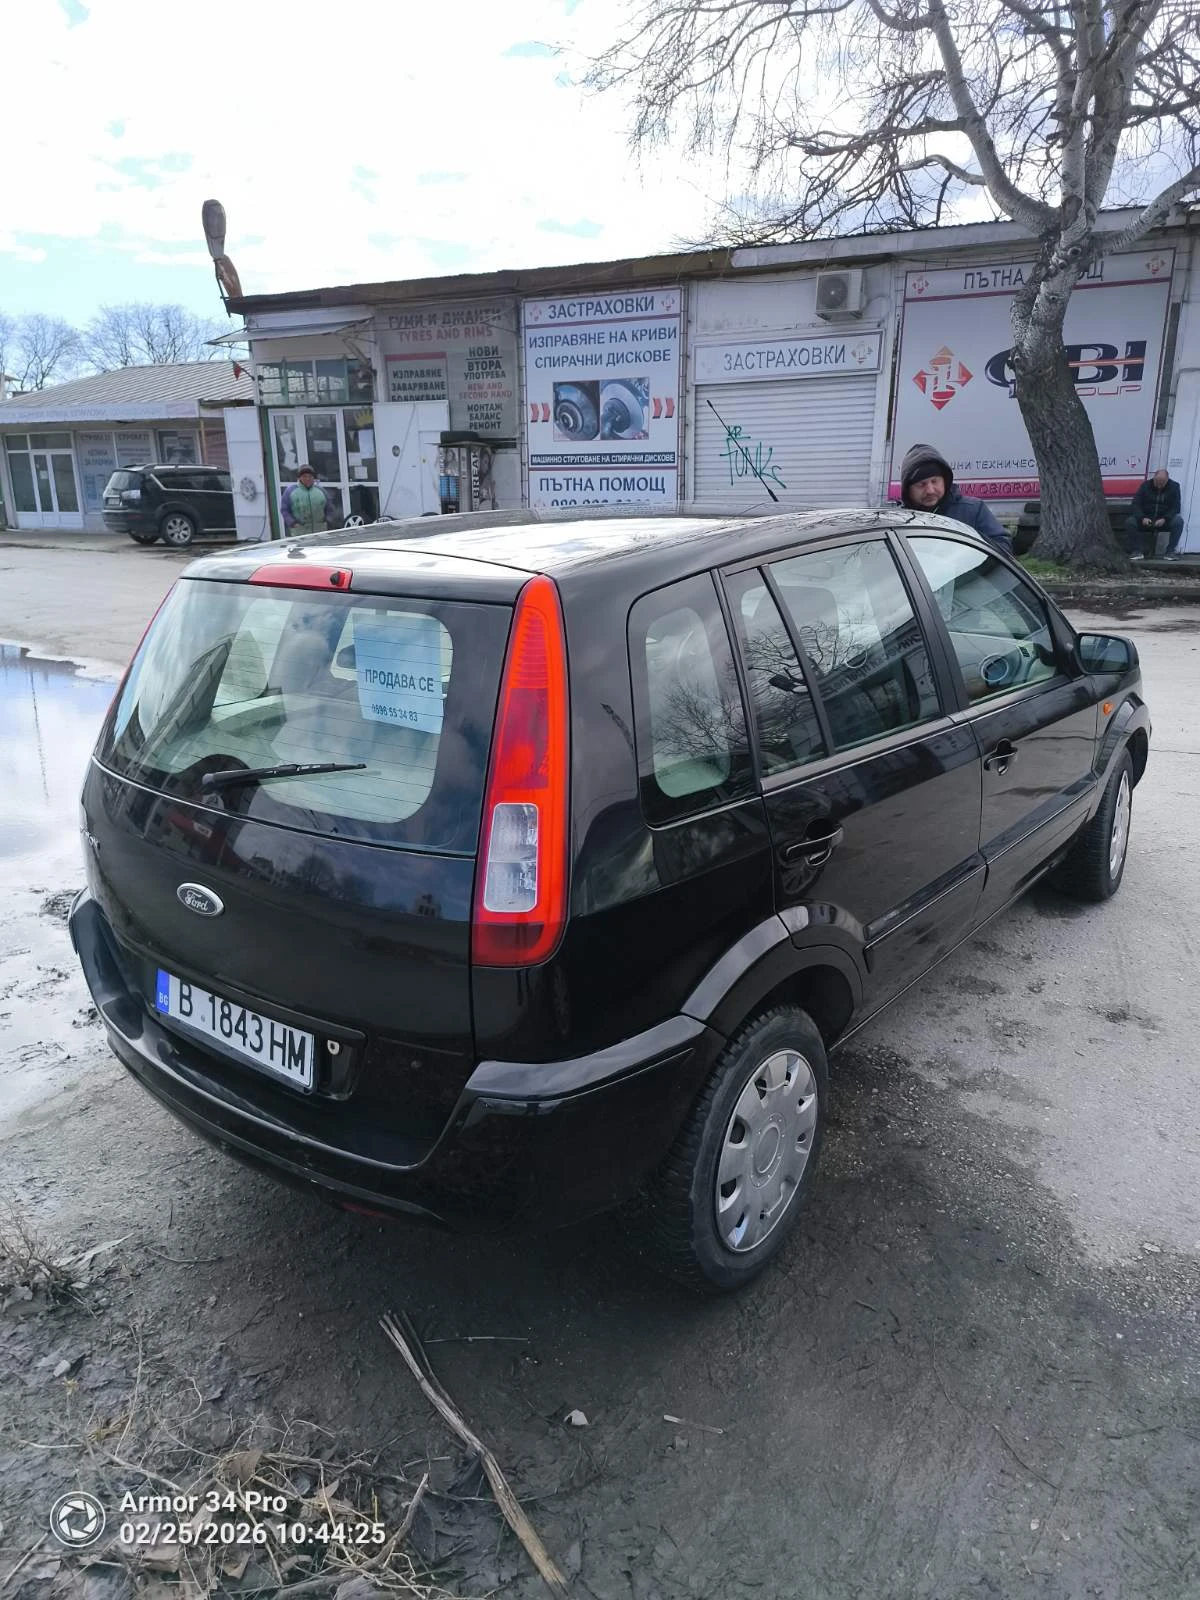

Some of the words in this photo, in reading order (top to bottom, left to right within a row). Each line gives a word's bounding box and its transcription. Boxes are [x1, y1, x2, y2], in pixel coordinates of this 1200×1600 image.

[964, 268, 1025, 289] ПЪТНА
[548, 296, 654, 320] ЗАСТРАХОВКИ
[389, 313, 423, 329] ГУМИ
[428, 312, 437, 326] И
[399, 330, 432, 343] TYRES
[437, 327, 460, 340] AND
[464, 325, 493, 339] RIMS
[529, 332, 605, 349] ИЗПРАВЯНЕ
[609, 330, 627, 344] НА
[631, 327, 677, 342] КРИВИ
[468, 345, 499, 358] НОВИ
[535, 354, 602, 369] СПИРАЧНИ
[606, 349, 671, 367] ДИСКОВЕ
[724, 344, 845, 371] ЗАСТРАХОВКИ
[467, 360, 502, 371] ВТОРА
[392, 368, 442, 379] ИЗПРАВЯНЕ
[463, 370, 506, 380] УПОТРЕБА
[391, 381, 446, 391] ЗАВАРЯВАНЕ
[467, 403, 502, 412] МОНТАЖ
[469, 412, 501, 421] БАЛАНС
[469, 421, 502, 430] РЕМОНТ
[532, 455, 562, 463] МАШИННО
[563, 454, 600, 463] СТРУГОВАНЕ
[602, 454, 610, 462] НА
[611, 454, 643, 463] СПИРАЧНИ
[644, 453, 675, 463] ДИСКОВЕ
[539, 477, 594, 492] ПЪТНА
[599, 477, 665, 494] ПОМОЩ
[365, 669, 416, 690] ПРОДАВА
[419, 676, 435, 693] СЕ
[184, 889, 209, 912] Ford
[159, 992, 169, 1006] BG
